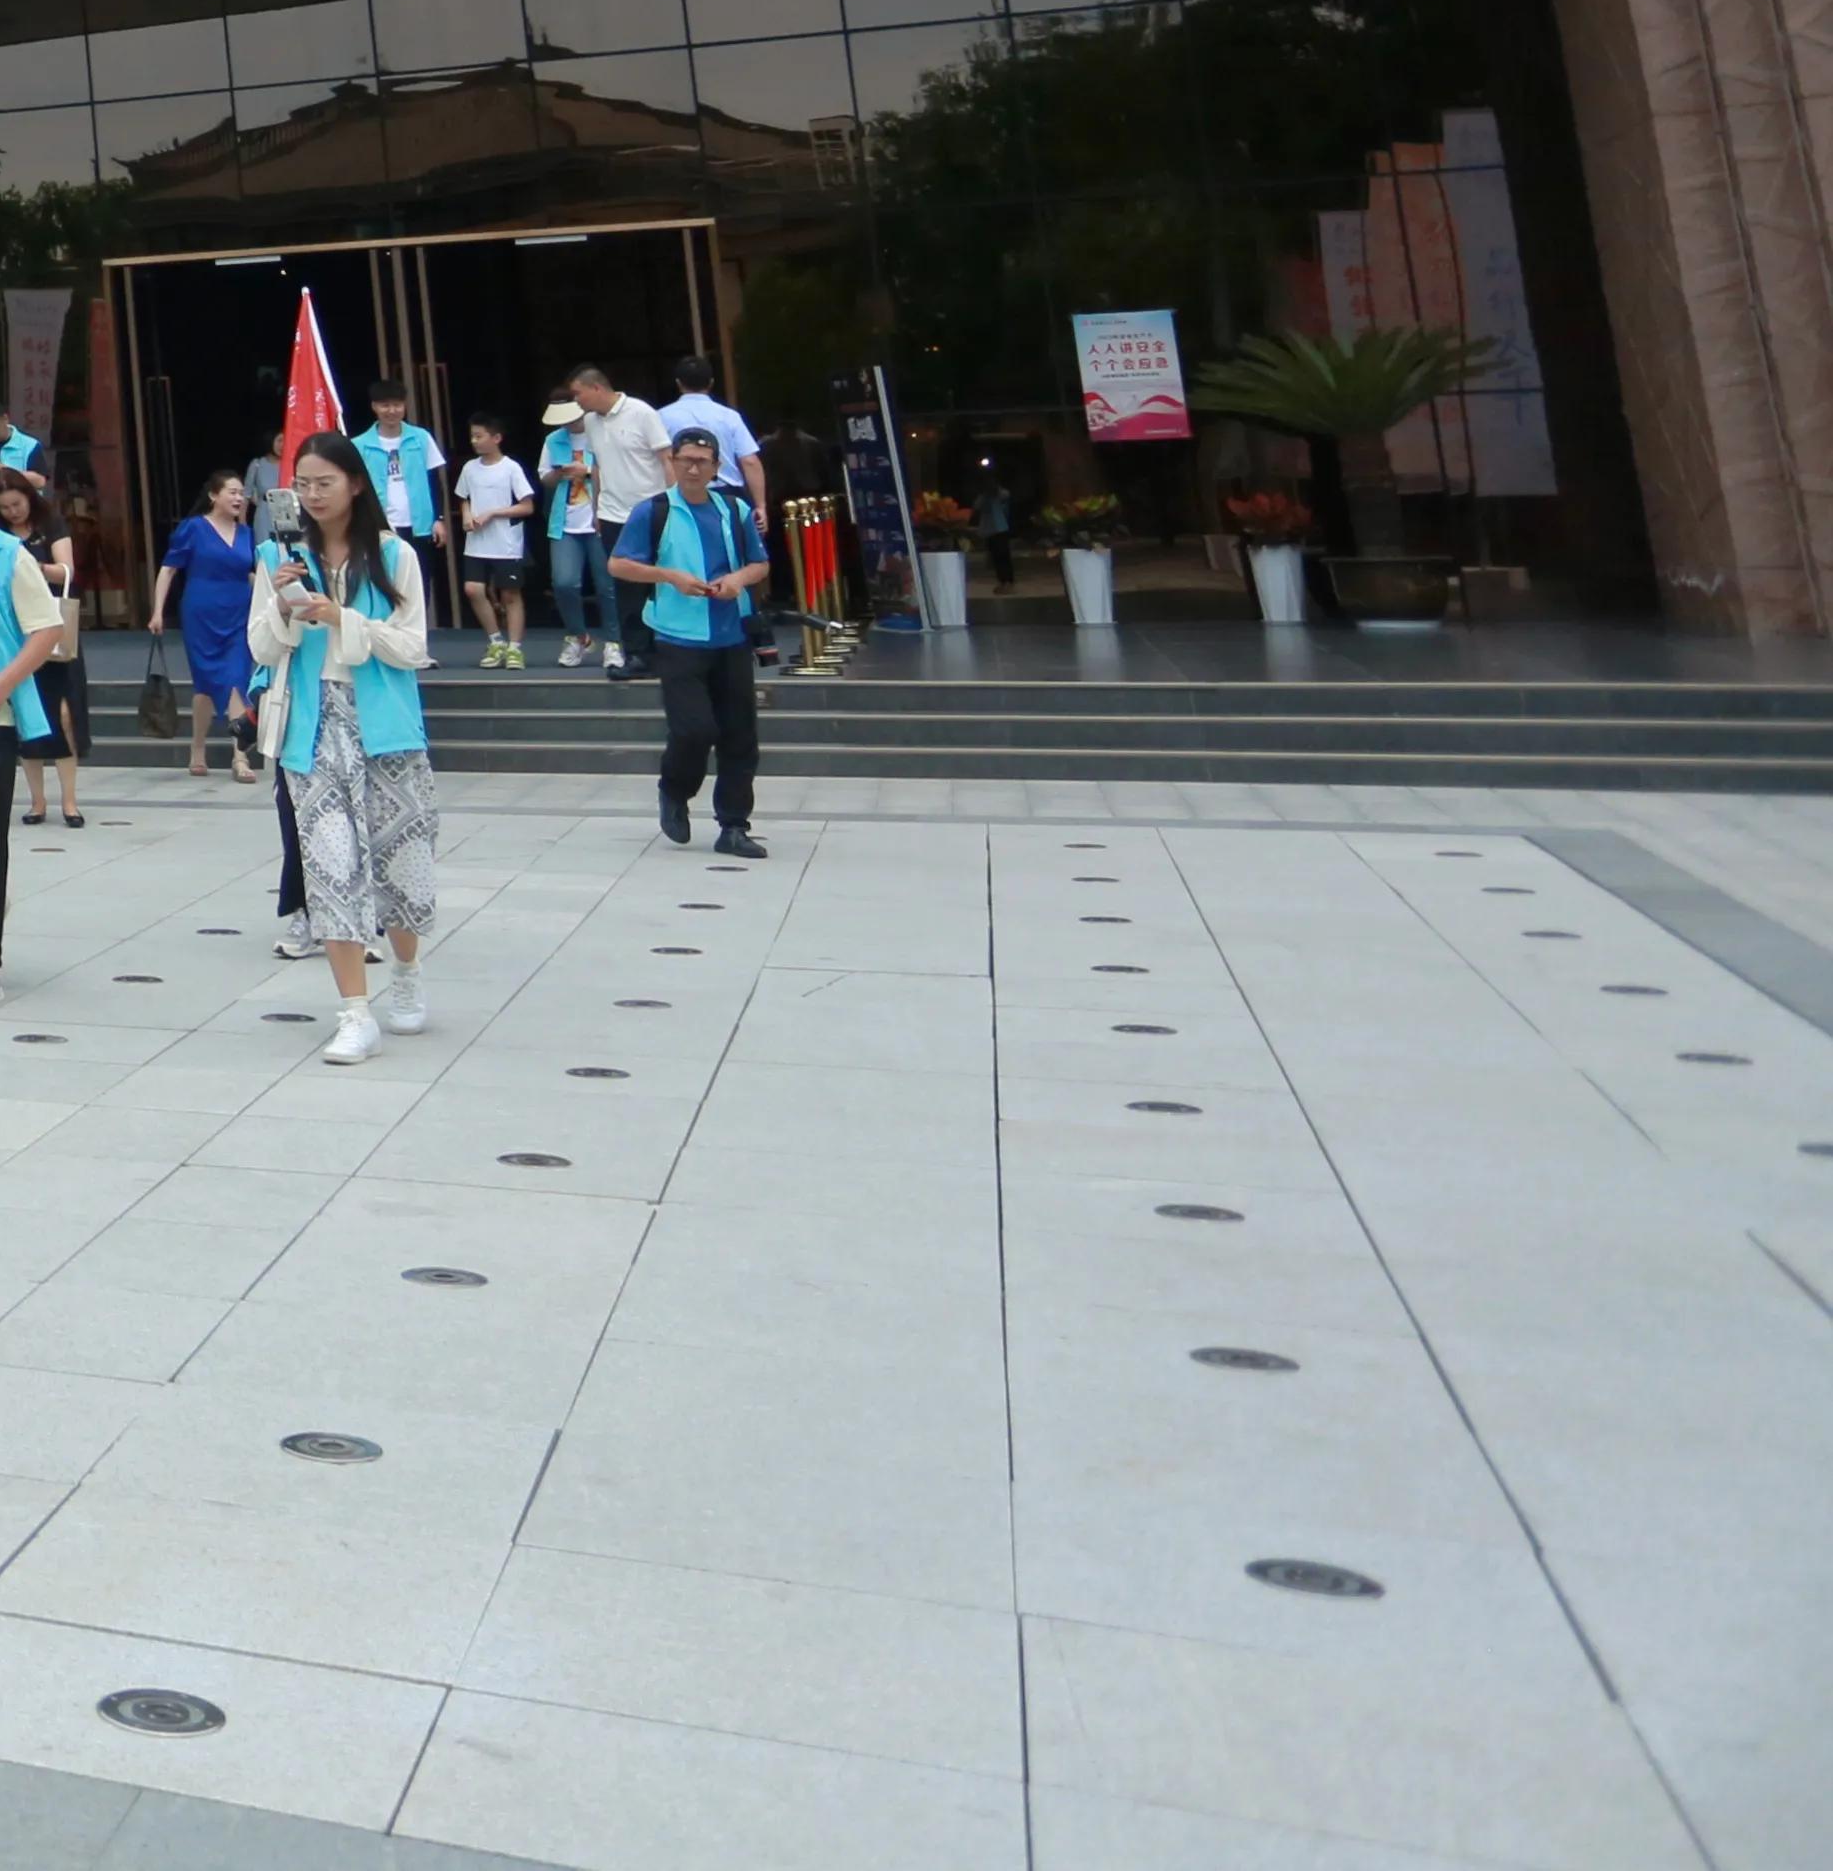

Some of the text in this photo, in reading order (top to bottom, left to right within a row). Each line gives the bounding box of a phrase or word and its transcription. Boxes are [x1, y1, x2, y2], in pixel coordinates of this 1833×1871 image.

[1088, 341, 1166, 355] 人人讲安全
[1090, 358, 1169, 371] 个个会应急
